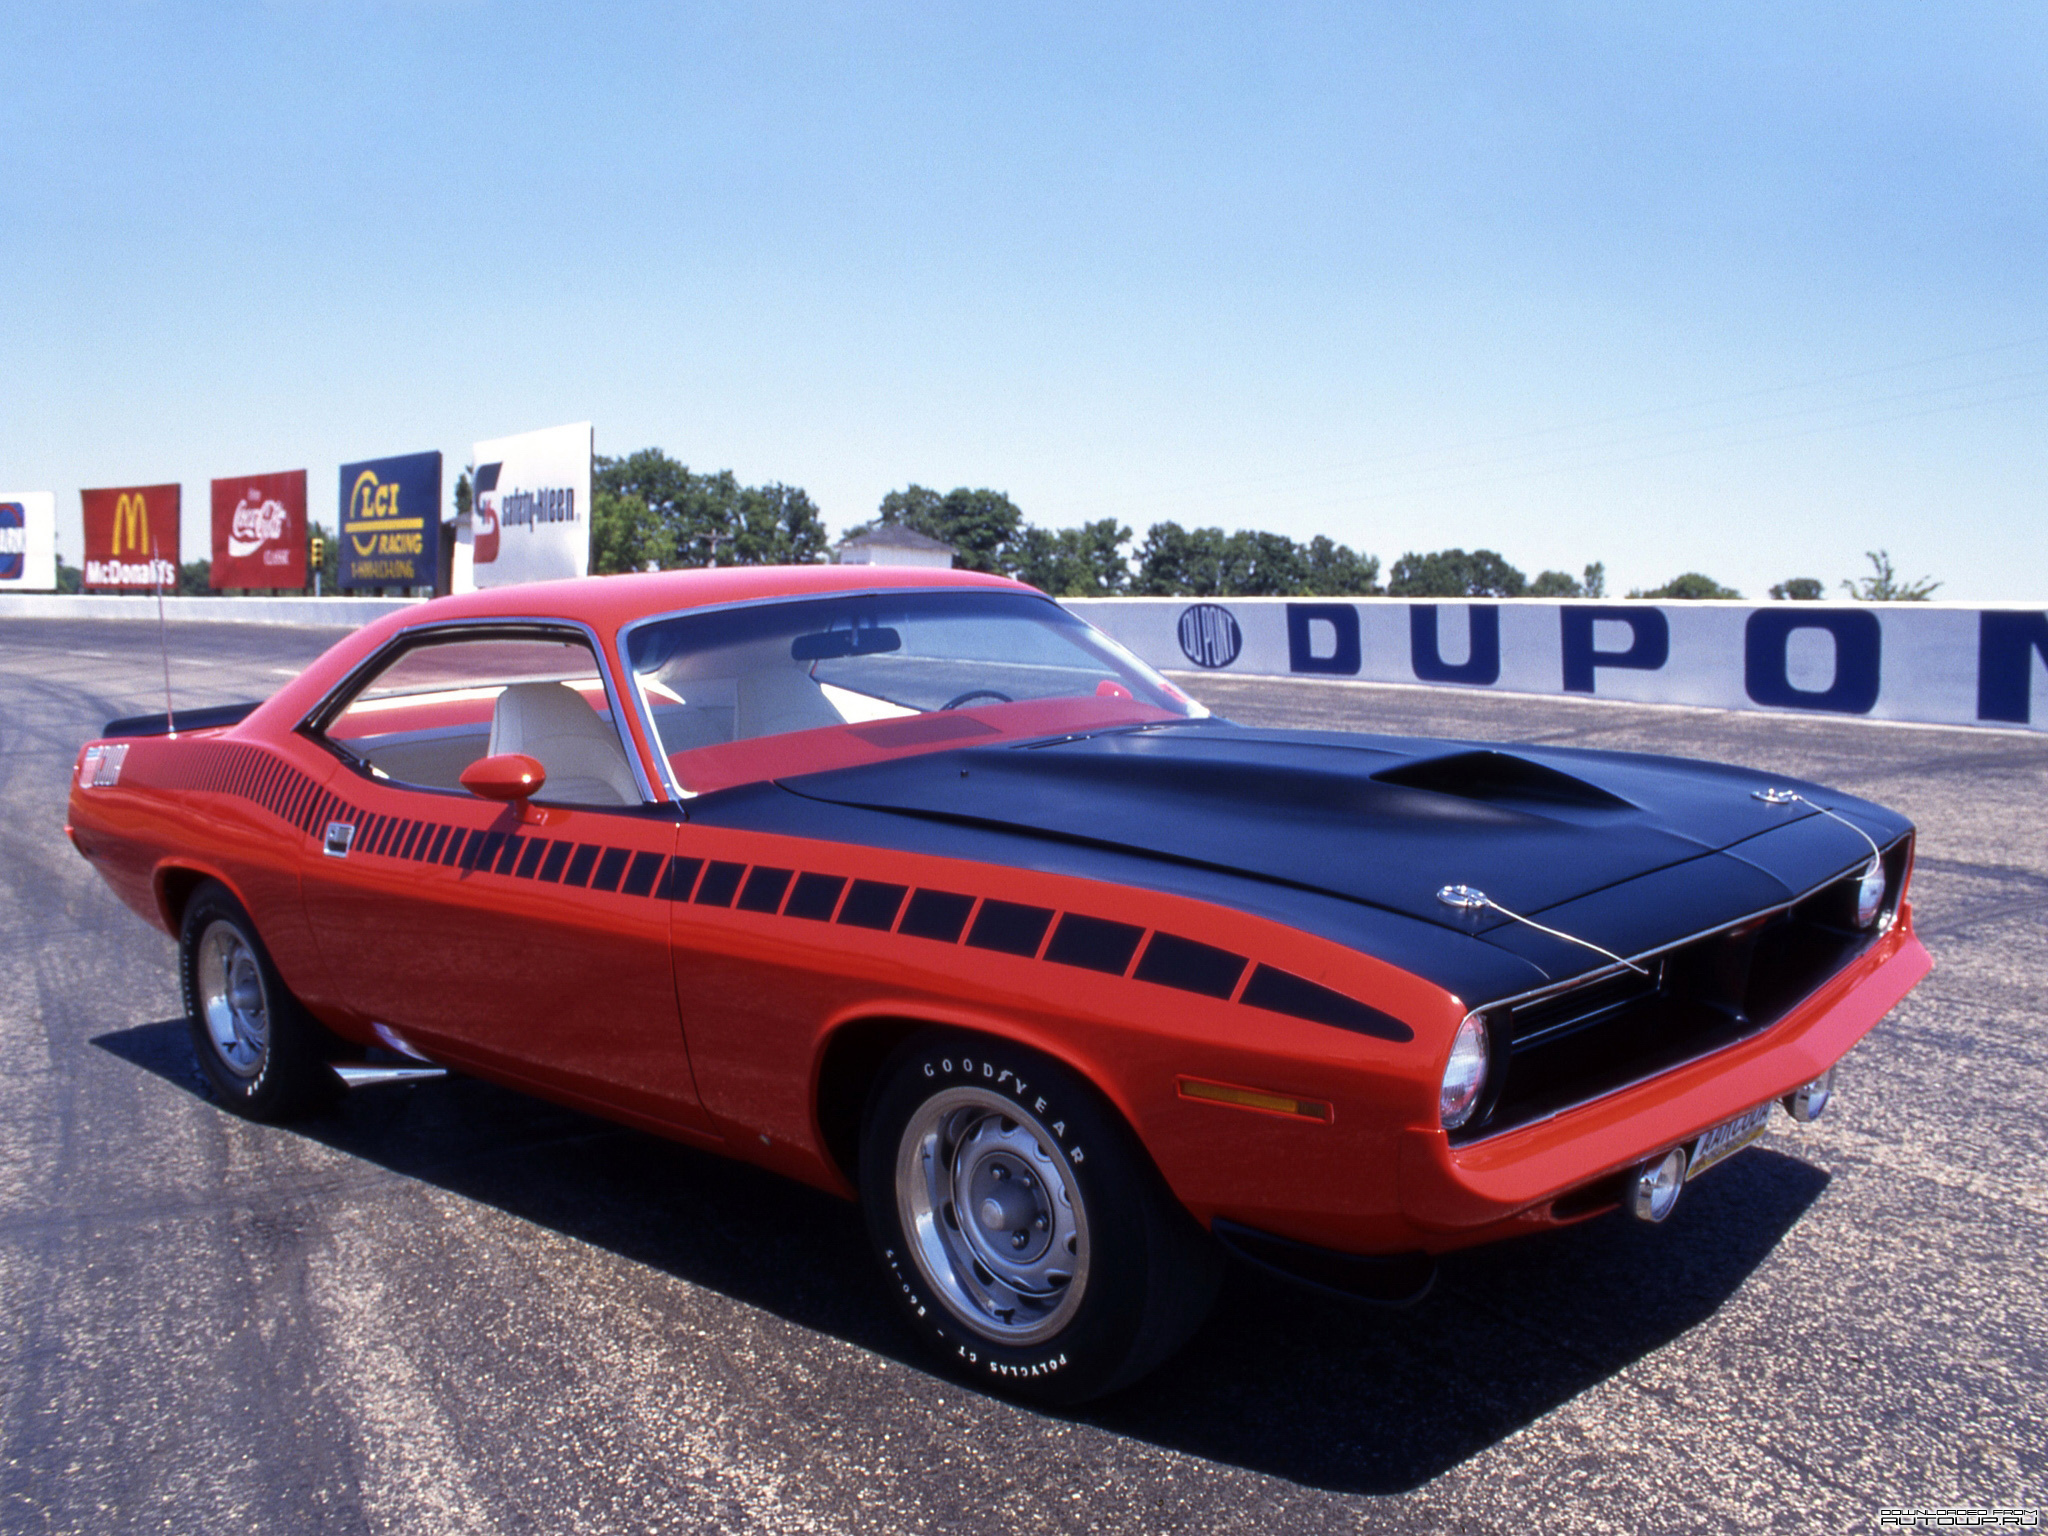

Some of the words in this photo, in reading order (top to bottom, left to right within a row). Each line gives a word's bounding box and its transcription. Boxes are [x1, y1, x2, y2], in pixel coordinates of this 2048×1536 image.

[360, 483, 400, 517] LCI
[378, 533, 424, 555] RACING
[923, 1058, 1085, 1164] GOODYEAR
